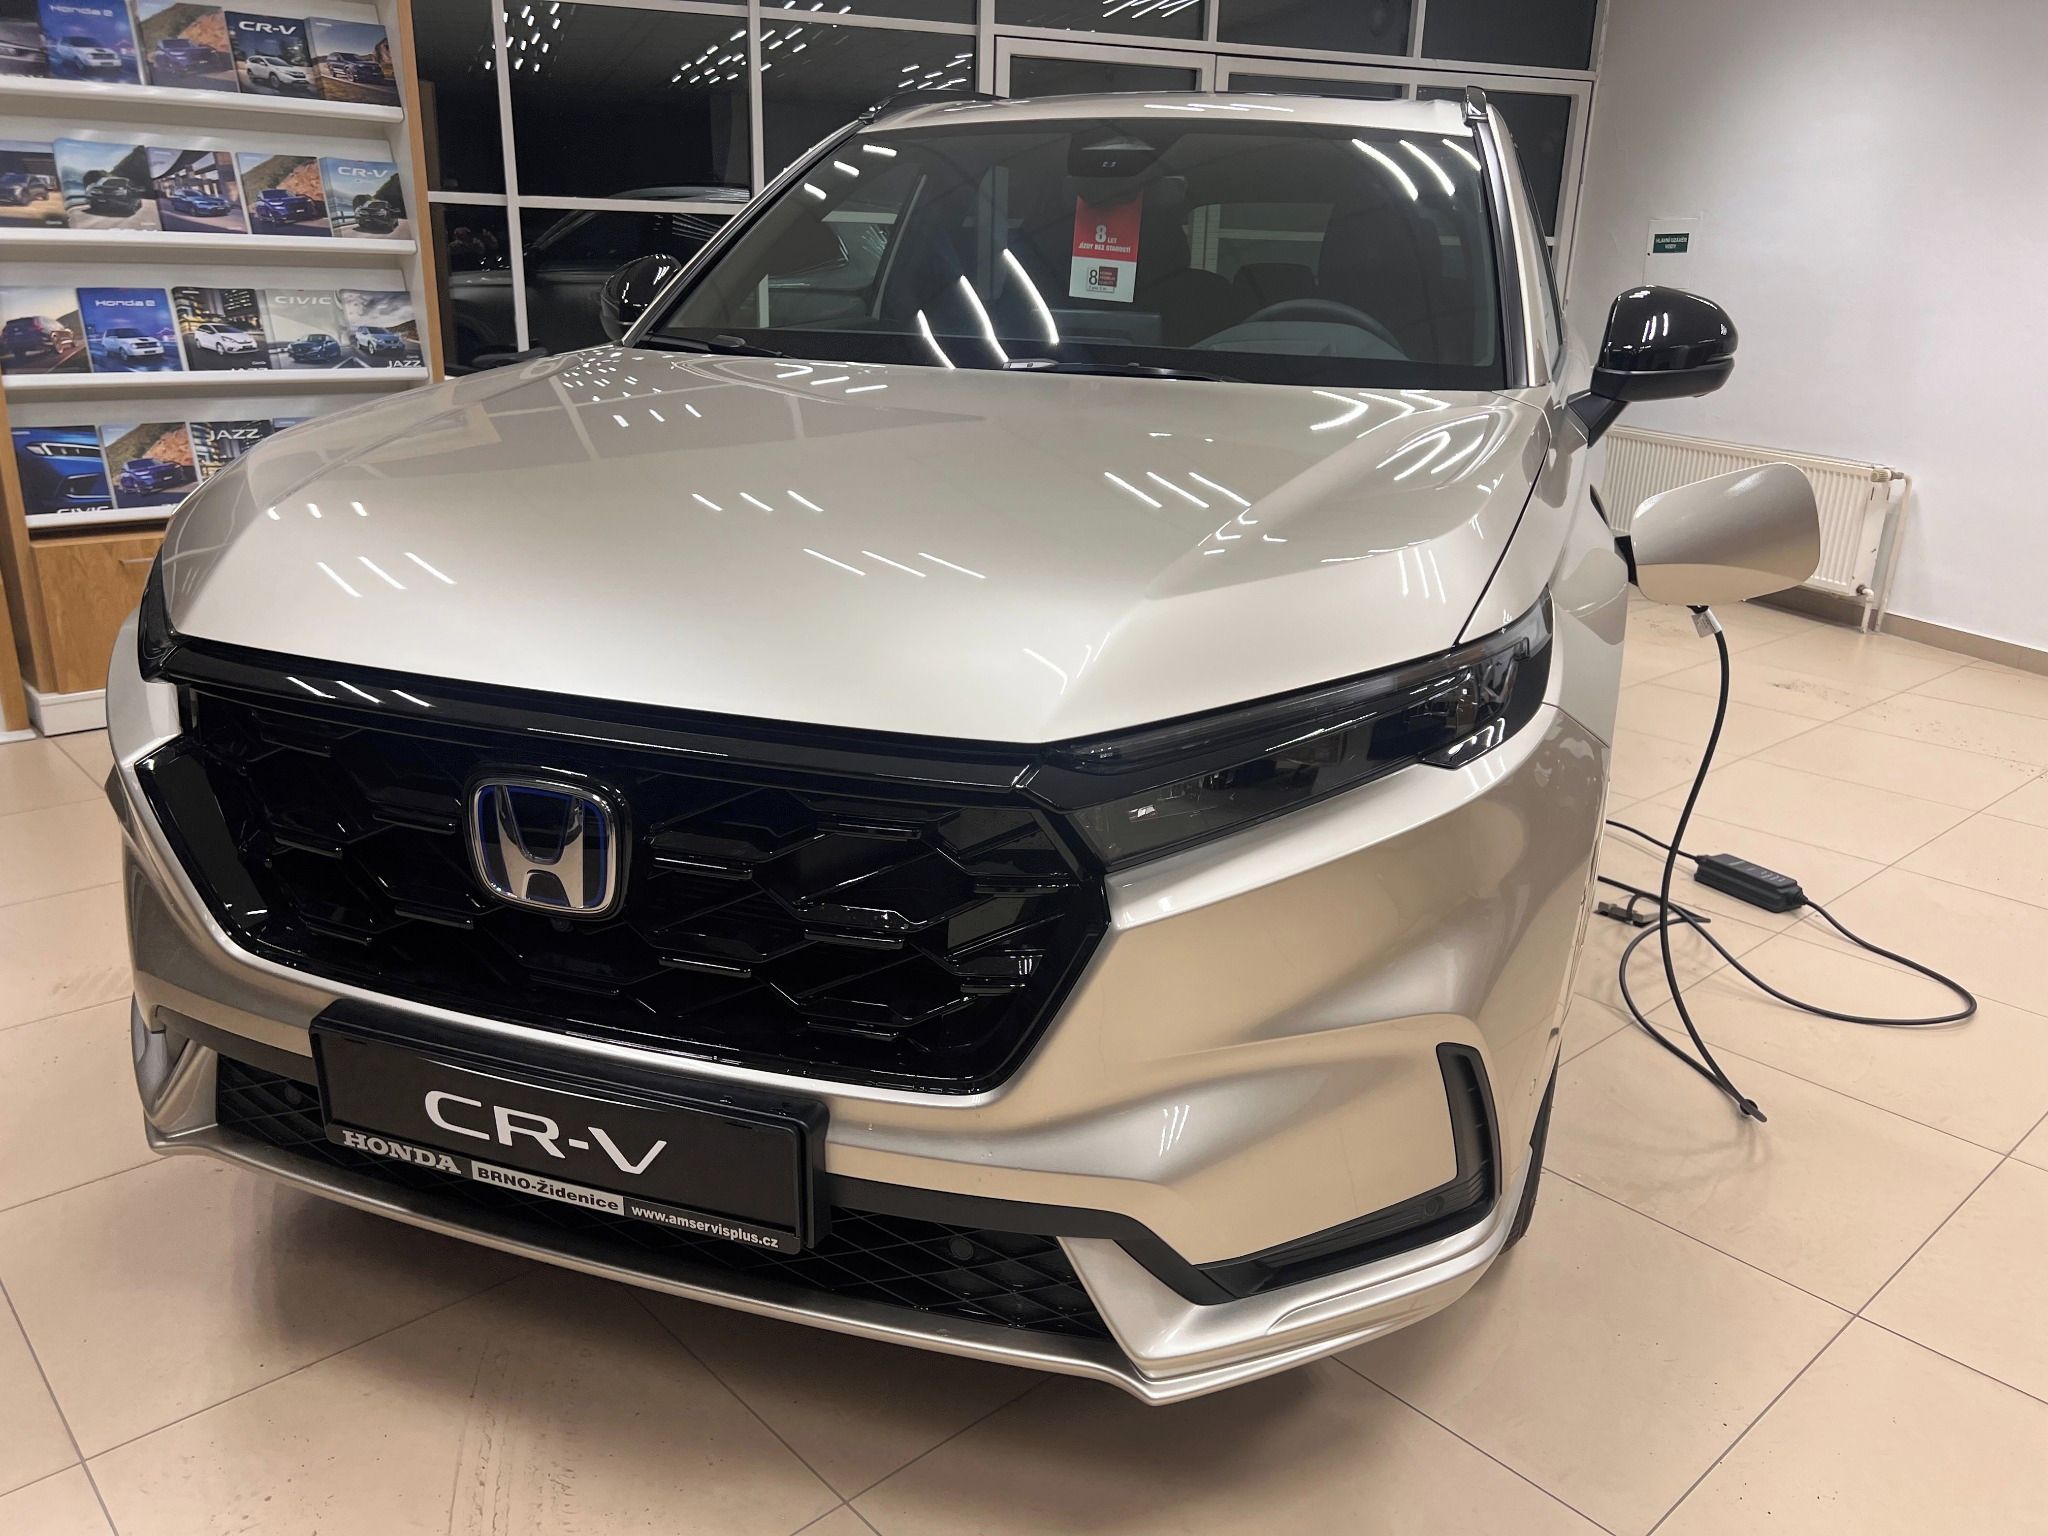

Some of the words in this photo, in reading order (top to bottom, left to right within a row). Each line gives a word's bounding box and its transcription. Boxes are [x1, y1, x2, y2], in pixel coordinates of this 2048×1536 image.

[238, 20, 297, 36] CR-V
[338, 167, 389, 178] CR-V
[1095, 224, 1107, 243] 8
[1089, 269, 1098, 285] 8
[274, 296, 331, 305] CIVIC
[387, 360, 422, 368] JAZZ
[208, 428, 262, 441] JAZZ
[424, 1090, 667, 1175] CR-V
[342, 1130, 462, 1174] HONDA
[477, 1166, 619, 1212] BRNO-Židenice
[630, 1204, 779, 1249] www.amservisplus.cz
